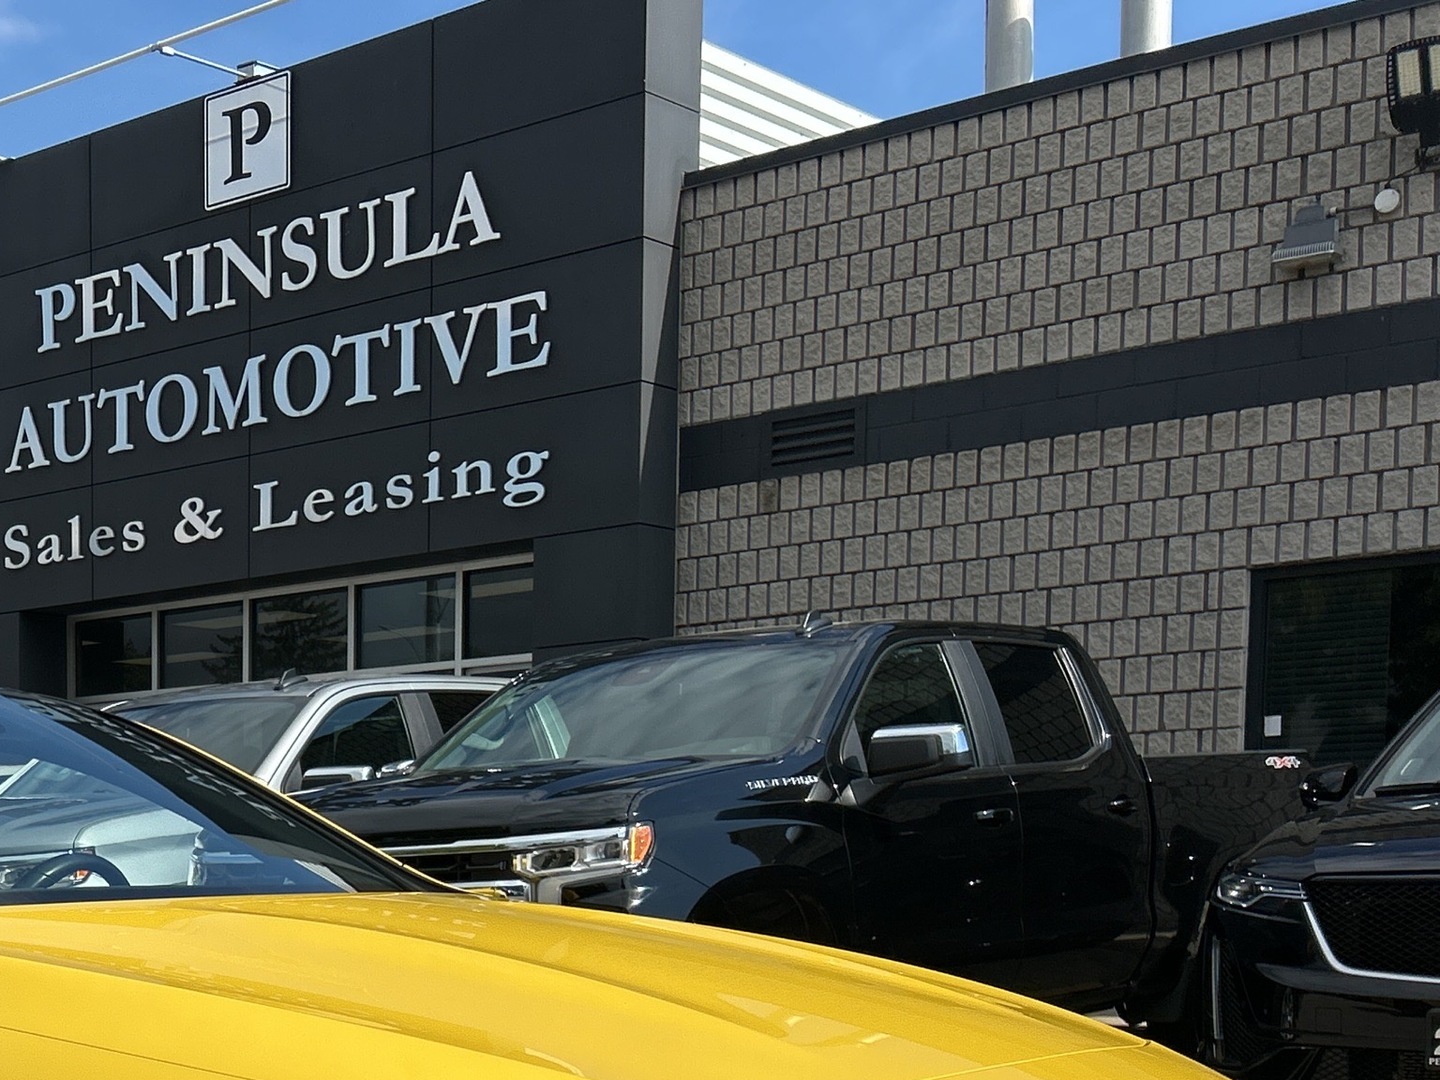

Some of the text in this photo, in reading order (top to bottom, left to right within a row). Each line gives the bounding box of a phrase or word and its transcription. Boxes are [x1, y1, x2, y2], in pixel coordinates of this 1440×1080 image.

[222, 101, 272, 185] P
[35, 171, 500, 354] PENINSULA
[4, 291, 551, 474] AUTOMOTIVE
[4, 449, 549, 570] Sales & Leasing
